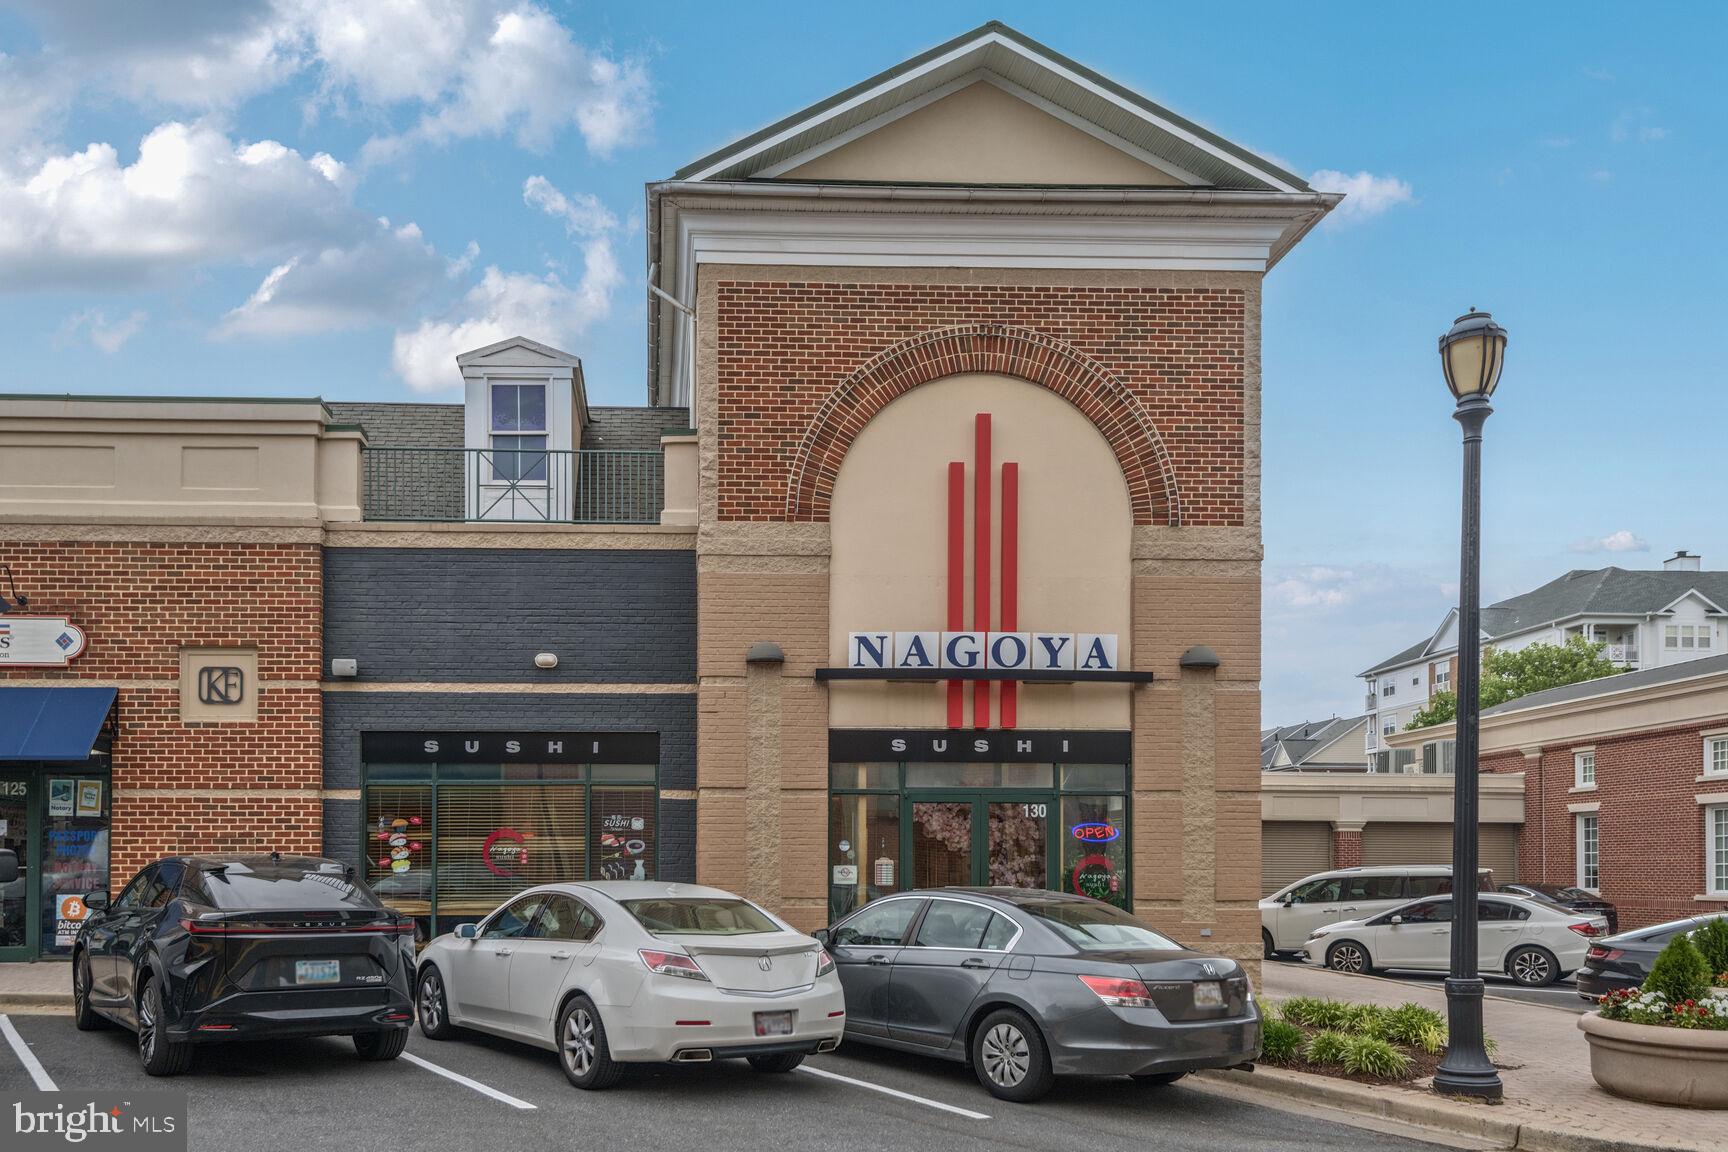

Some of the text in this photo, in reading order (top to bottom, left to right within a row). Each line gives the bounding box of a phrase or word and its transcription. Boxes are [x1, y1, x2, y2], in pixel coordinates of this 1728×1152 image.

[853, 635, 1113, 669] NAGOYA
[424, 740, 599, 754] SUSHI
[891, 739, 1069, 753] SUSHI
[3, 782, 27, 796] 125
[1023, 804, 1047, 818] 130
[604, 819, 630, 827] SUSHI
[1074, 825, 1115, 840] OPEN
